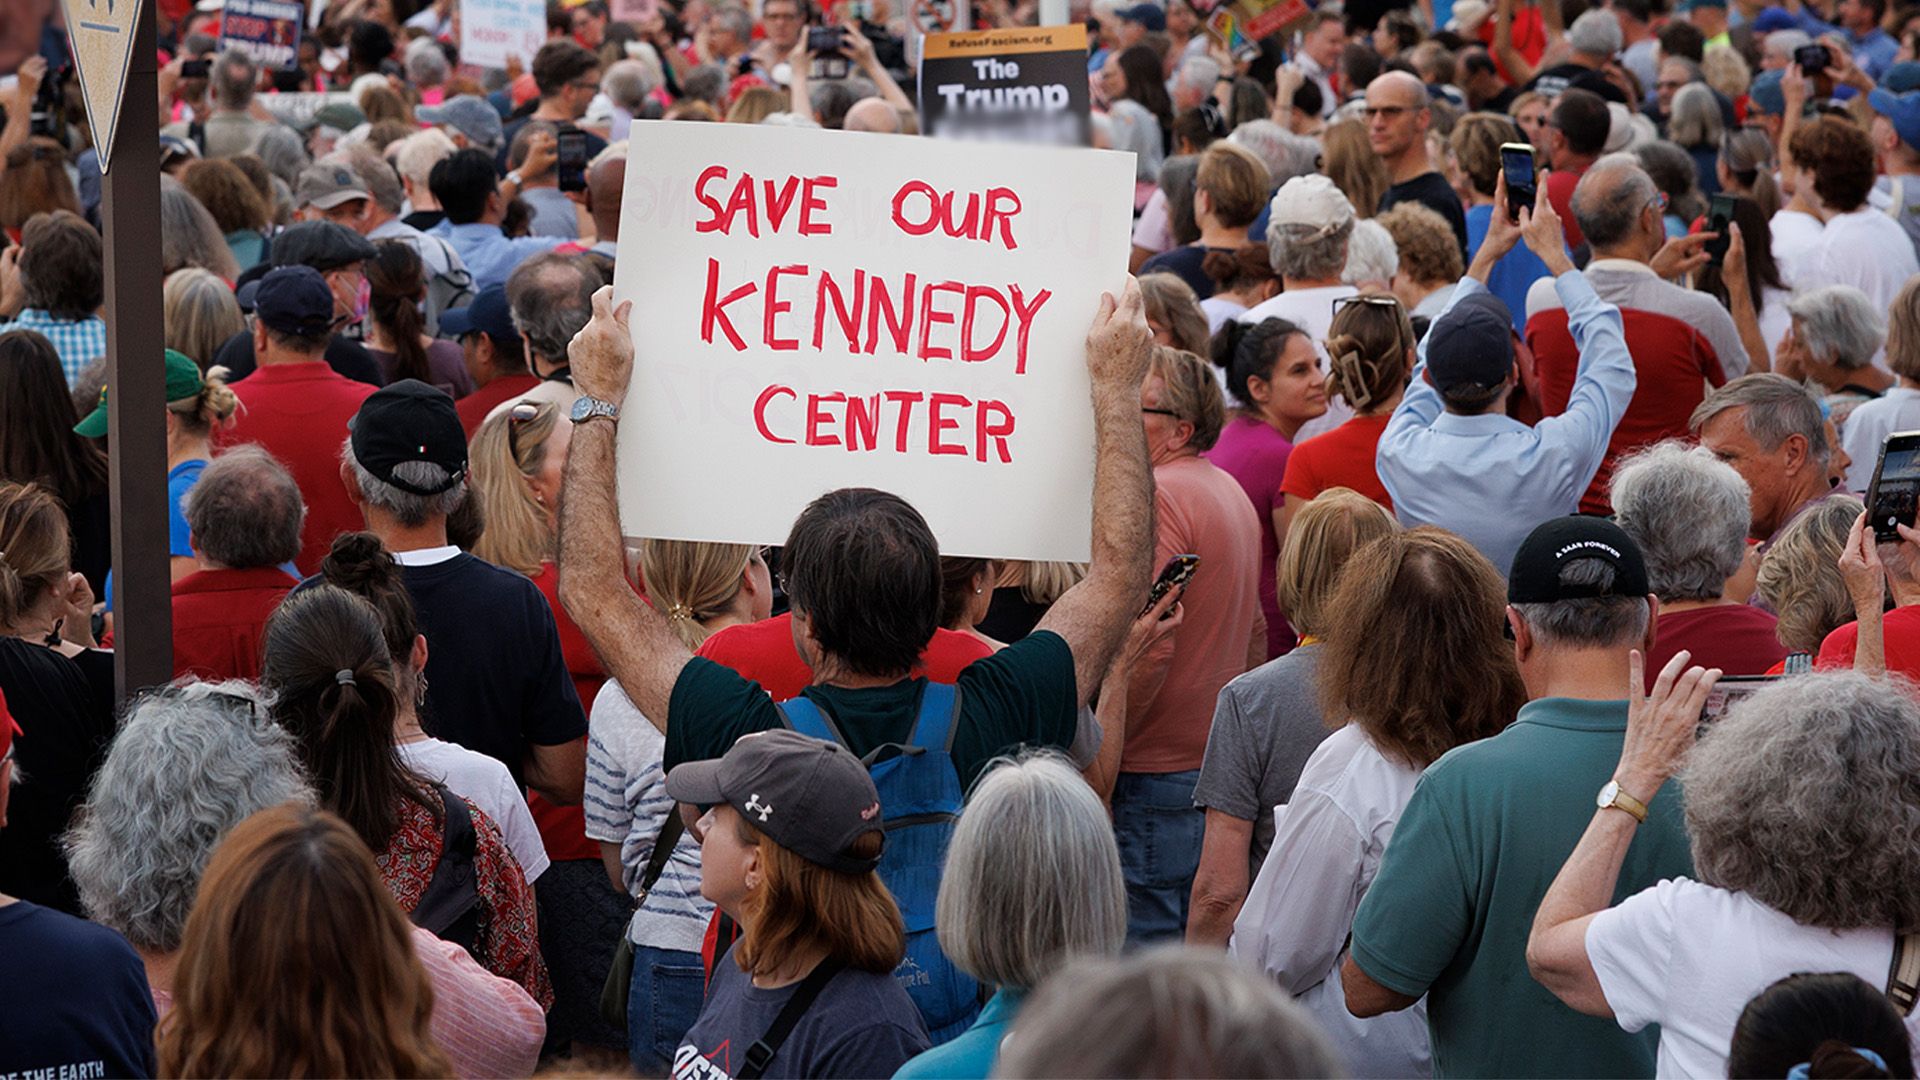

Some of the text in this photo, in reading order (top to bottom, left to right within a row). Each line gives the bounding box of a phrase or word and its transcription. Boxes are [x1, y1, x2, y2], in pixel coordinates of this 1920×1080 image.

[972, 58, 1020, 81] The
[937, 83, 1070, 112] Trump
[694, 164, 839, 240] SAVE
[891, 180, 1022, 250] OUR
[701, 257, 1053, 375] KENNEDY
[753, 383, 1016, 464] CENTER
[22, 1067, 56, 1080] THE
[59, 1060, 105, 1080] EARTH
